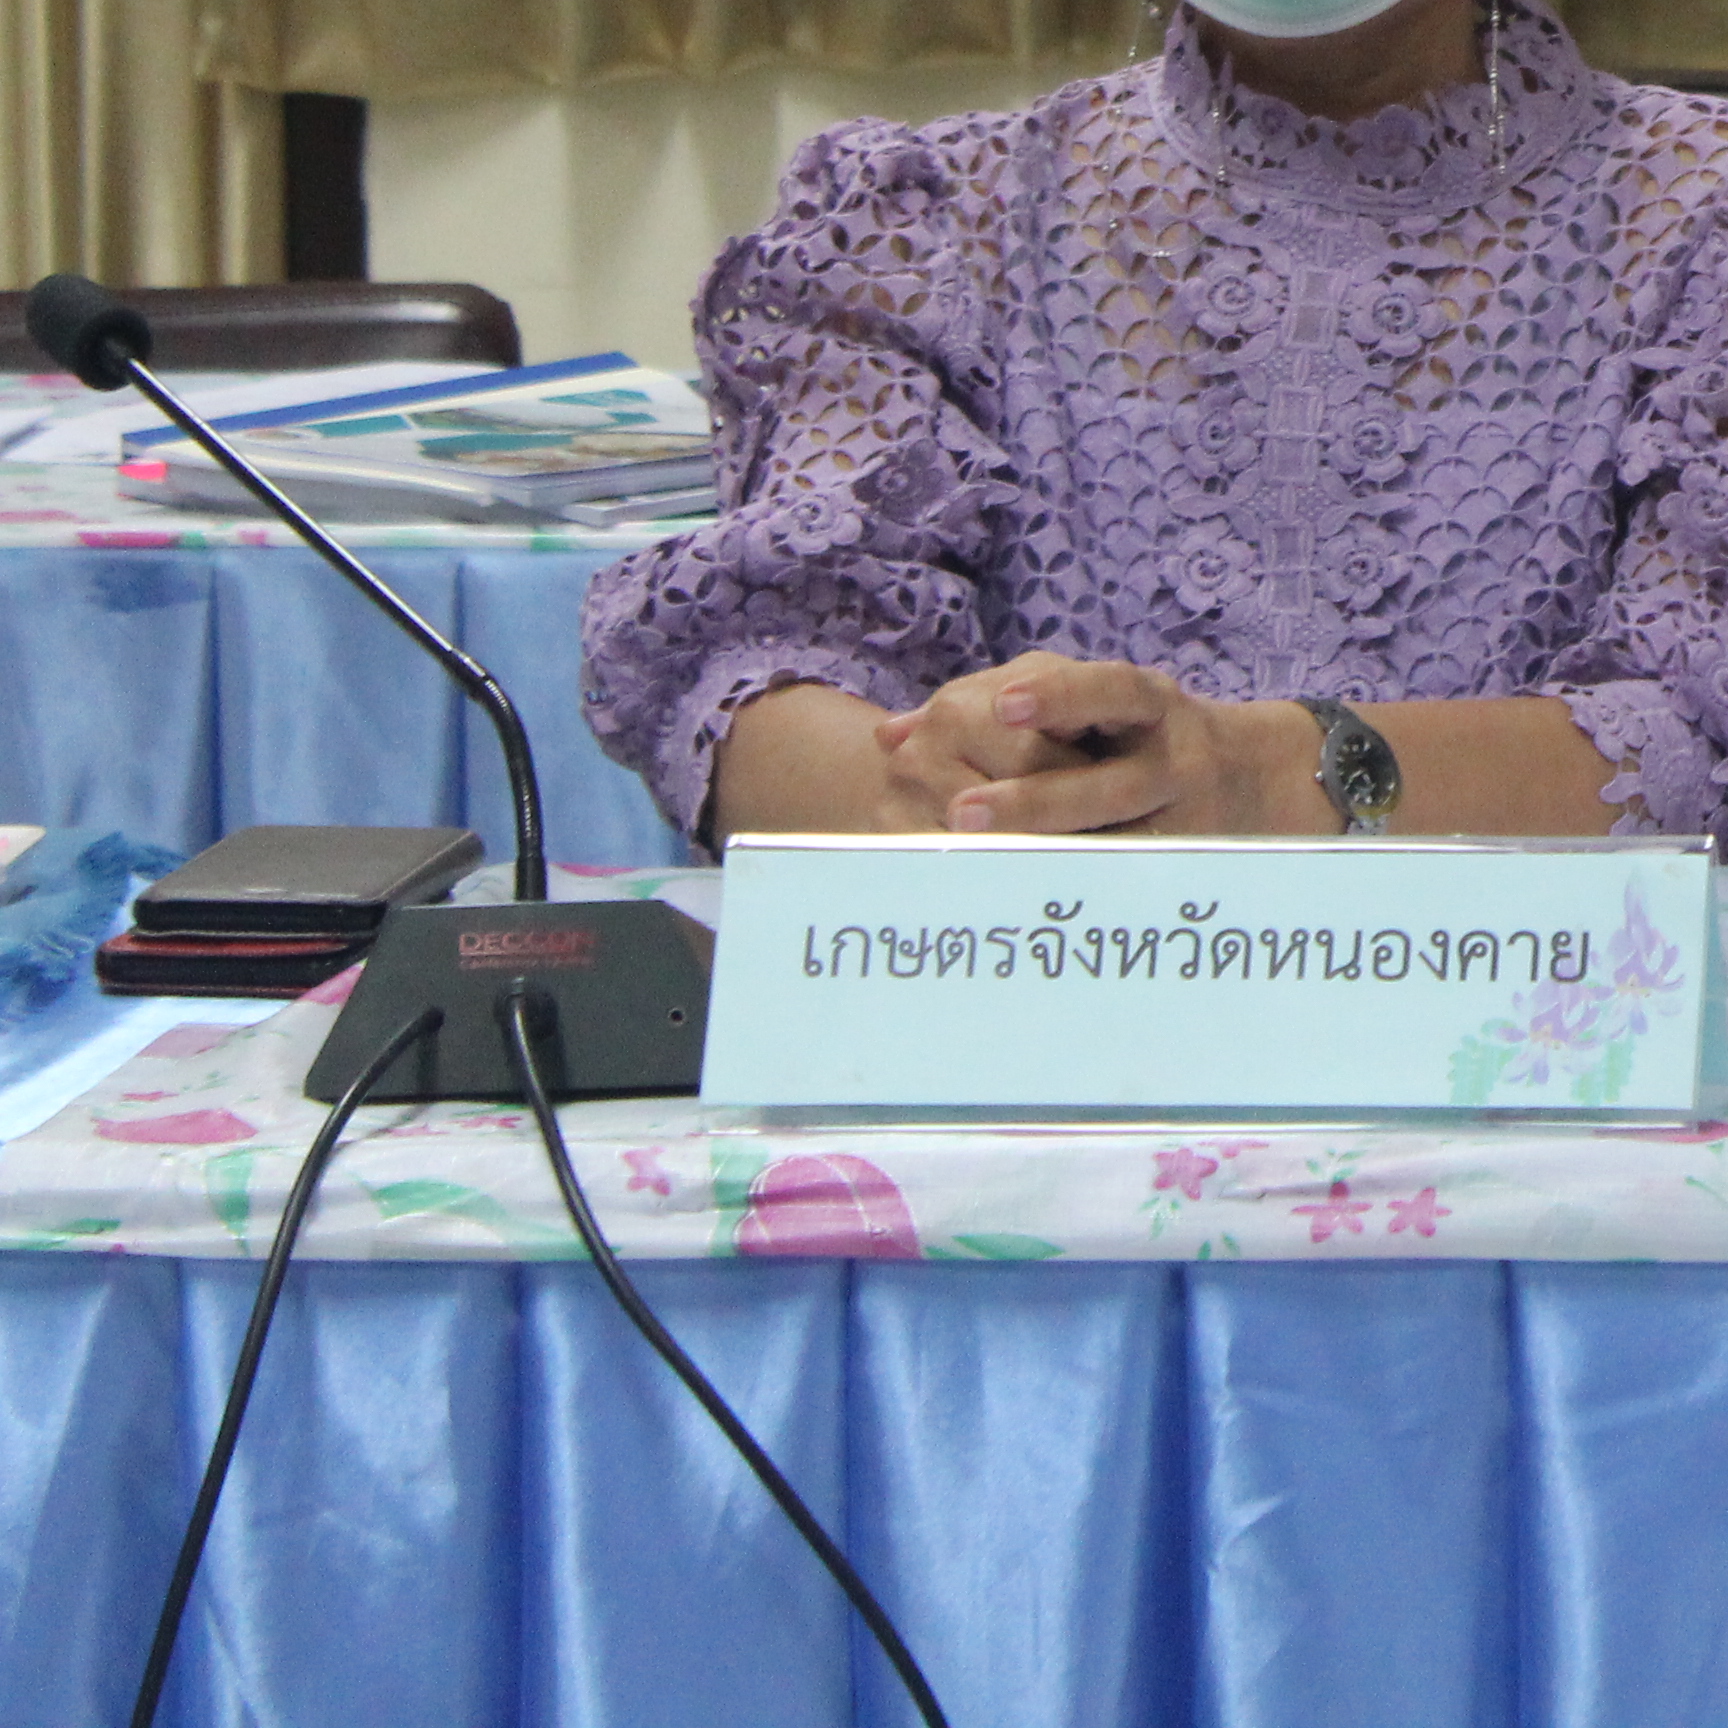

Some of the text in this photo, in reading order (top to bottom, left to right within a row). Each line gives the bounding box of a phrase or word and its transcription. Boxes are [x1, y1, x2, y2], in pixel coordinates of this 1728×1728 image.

[801, 899, 1592, 983] เกษตรจังหวัดหนองคาย
